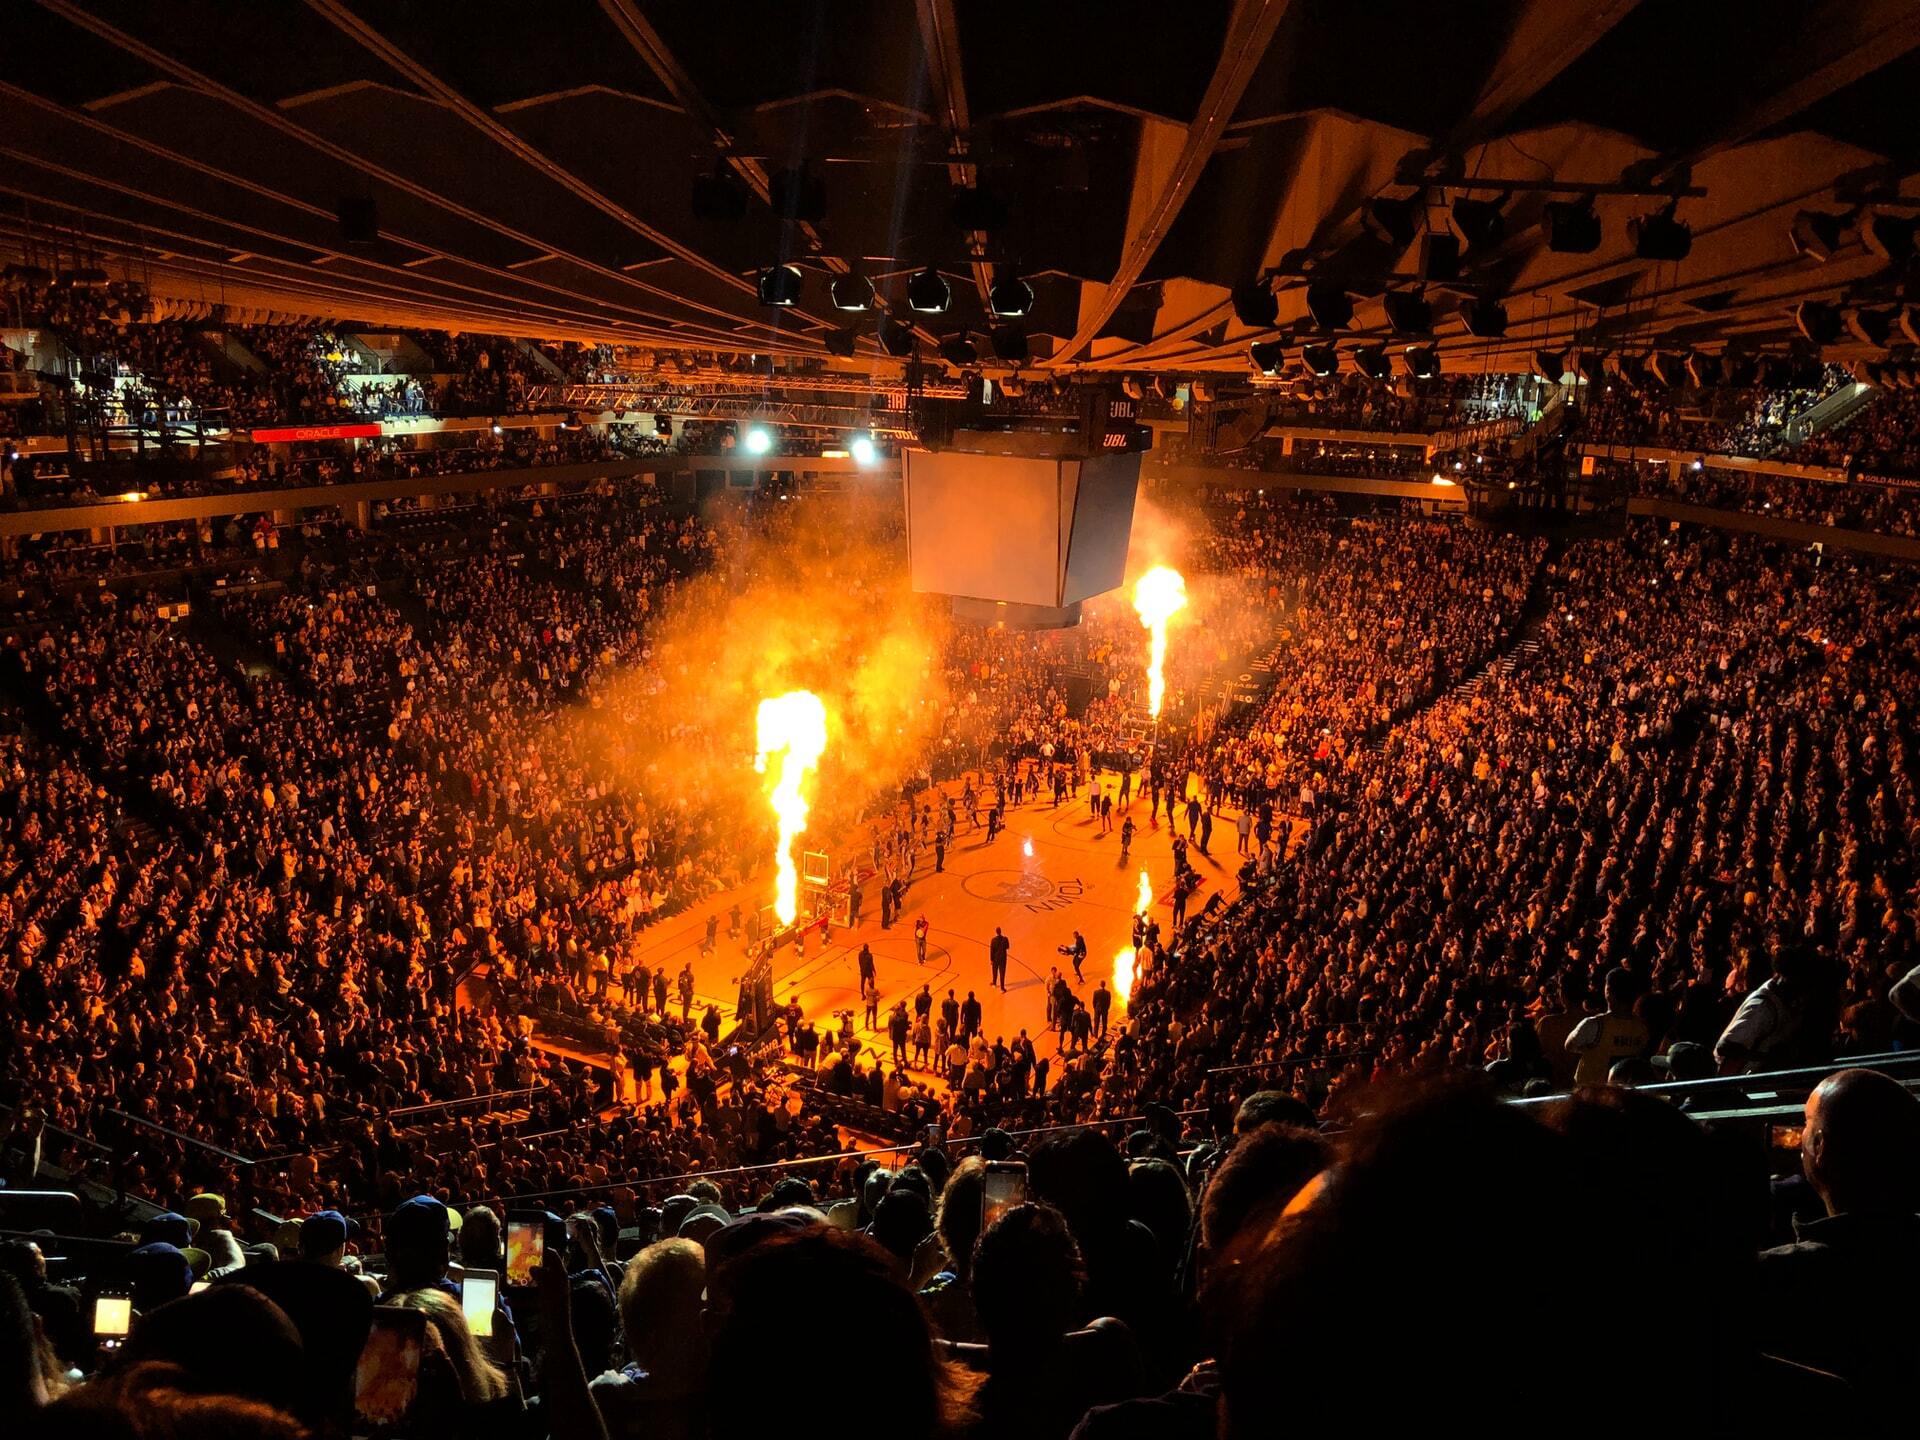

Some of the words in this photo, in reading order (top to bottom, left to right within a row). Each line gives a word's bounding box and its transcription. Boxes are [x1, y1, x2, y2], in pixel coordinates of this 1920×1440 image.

[1110, 401, 1134, 418] JBL
[296, 428, 340, 439] ORACLE
[1103, 434, 1127, 447] JBL
[1865, 474, 1886, 484] GOLD
[1024, 878, 1083, 914] TOWN
